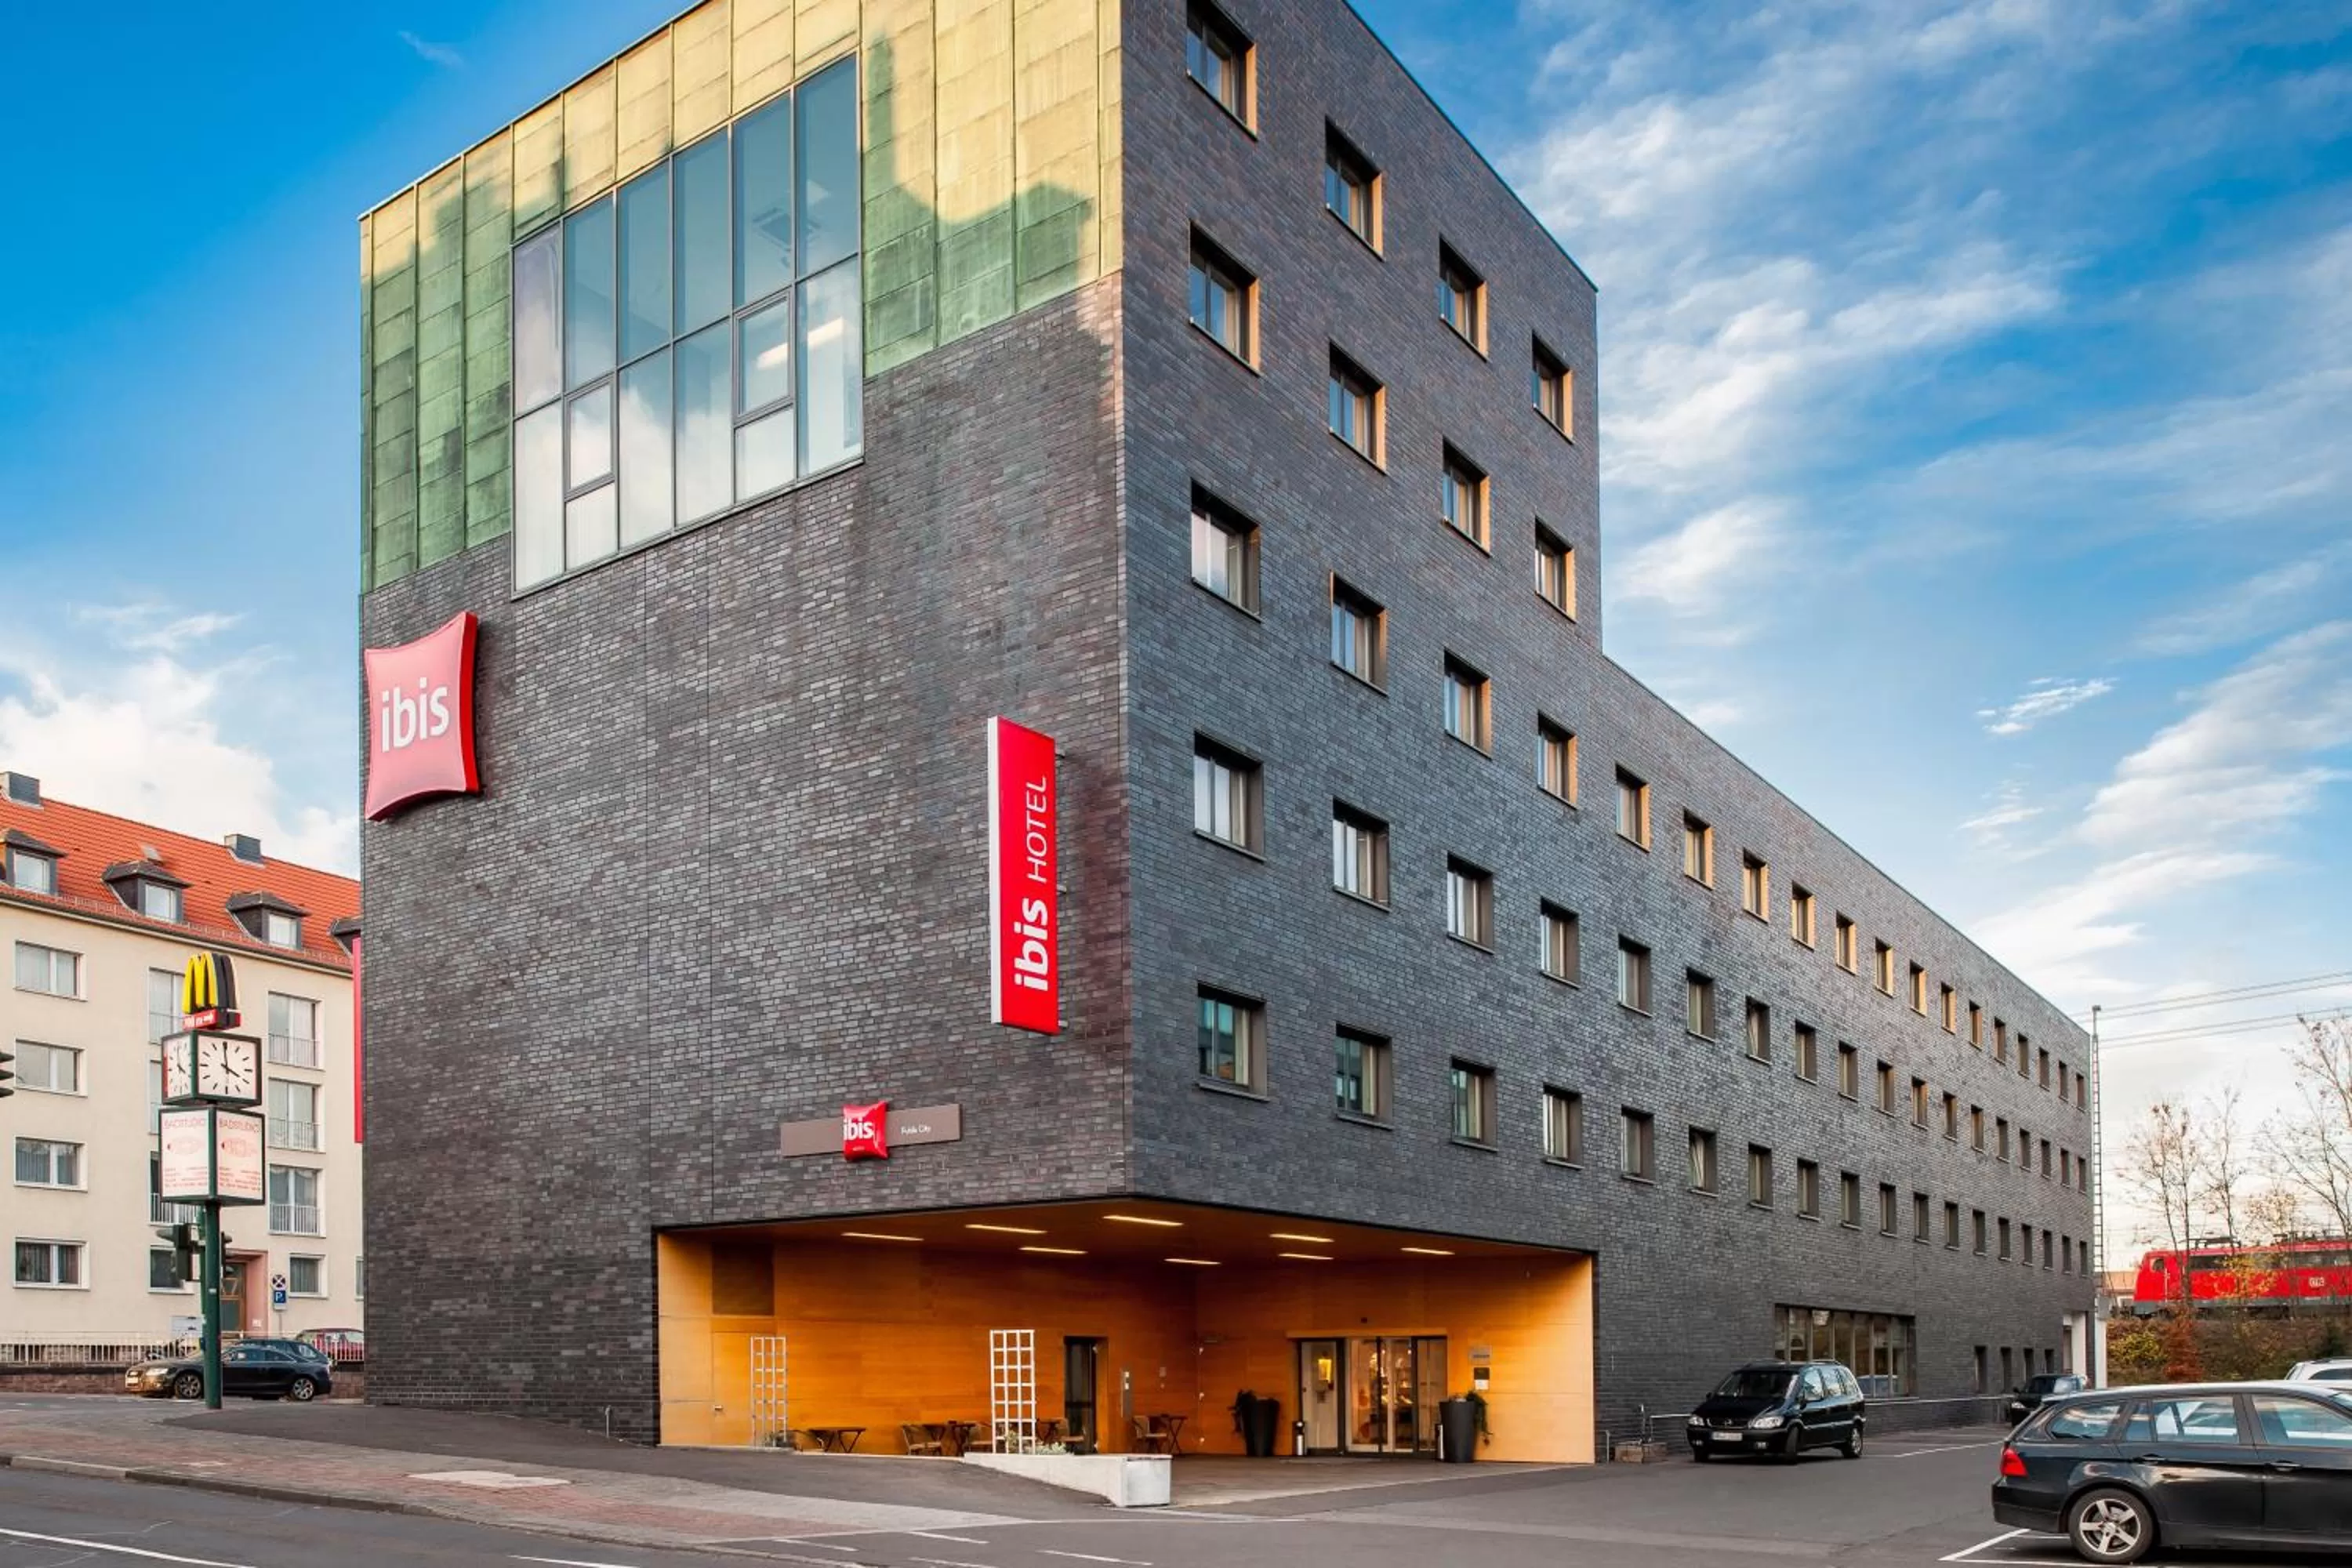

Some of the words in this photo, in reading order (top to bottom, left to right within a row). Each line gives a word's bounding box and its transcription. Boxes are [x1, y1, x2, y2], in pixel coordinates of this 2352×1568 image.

[382, 677, 449, 753] ibis
[1025, 776, 1047, 883] HOTEL
[1014, 898, 1049, 992] ibis
[844, 1116, 874, 1141] ibis
